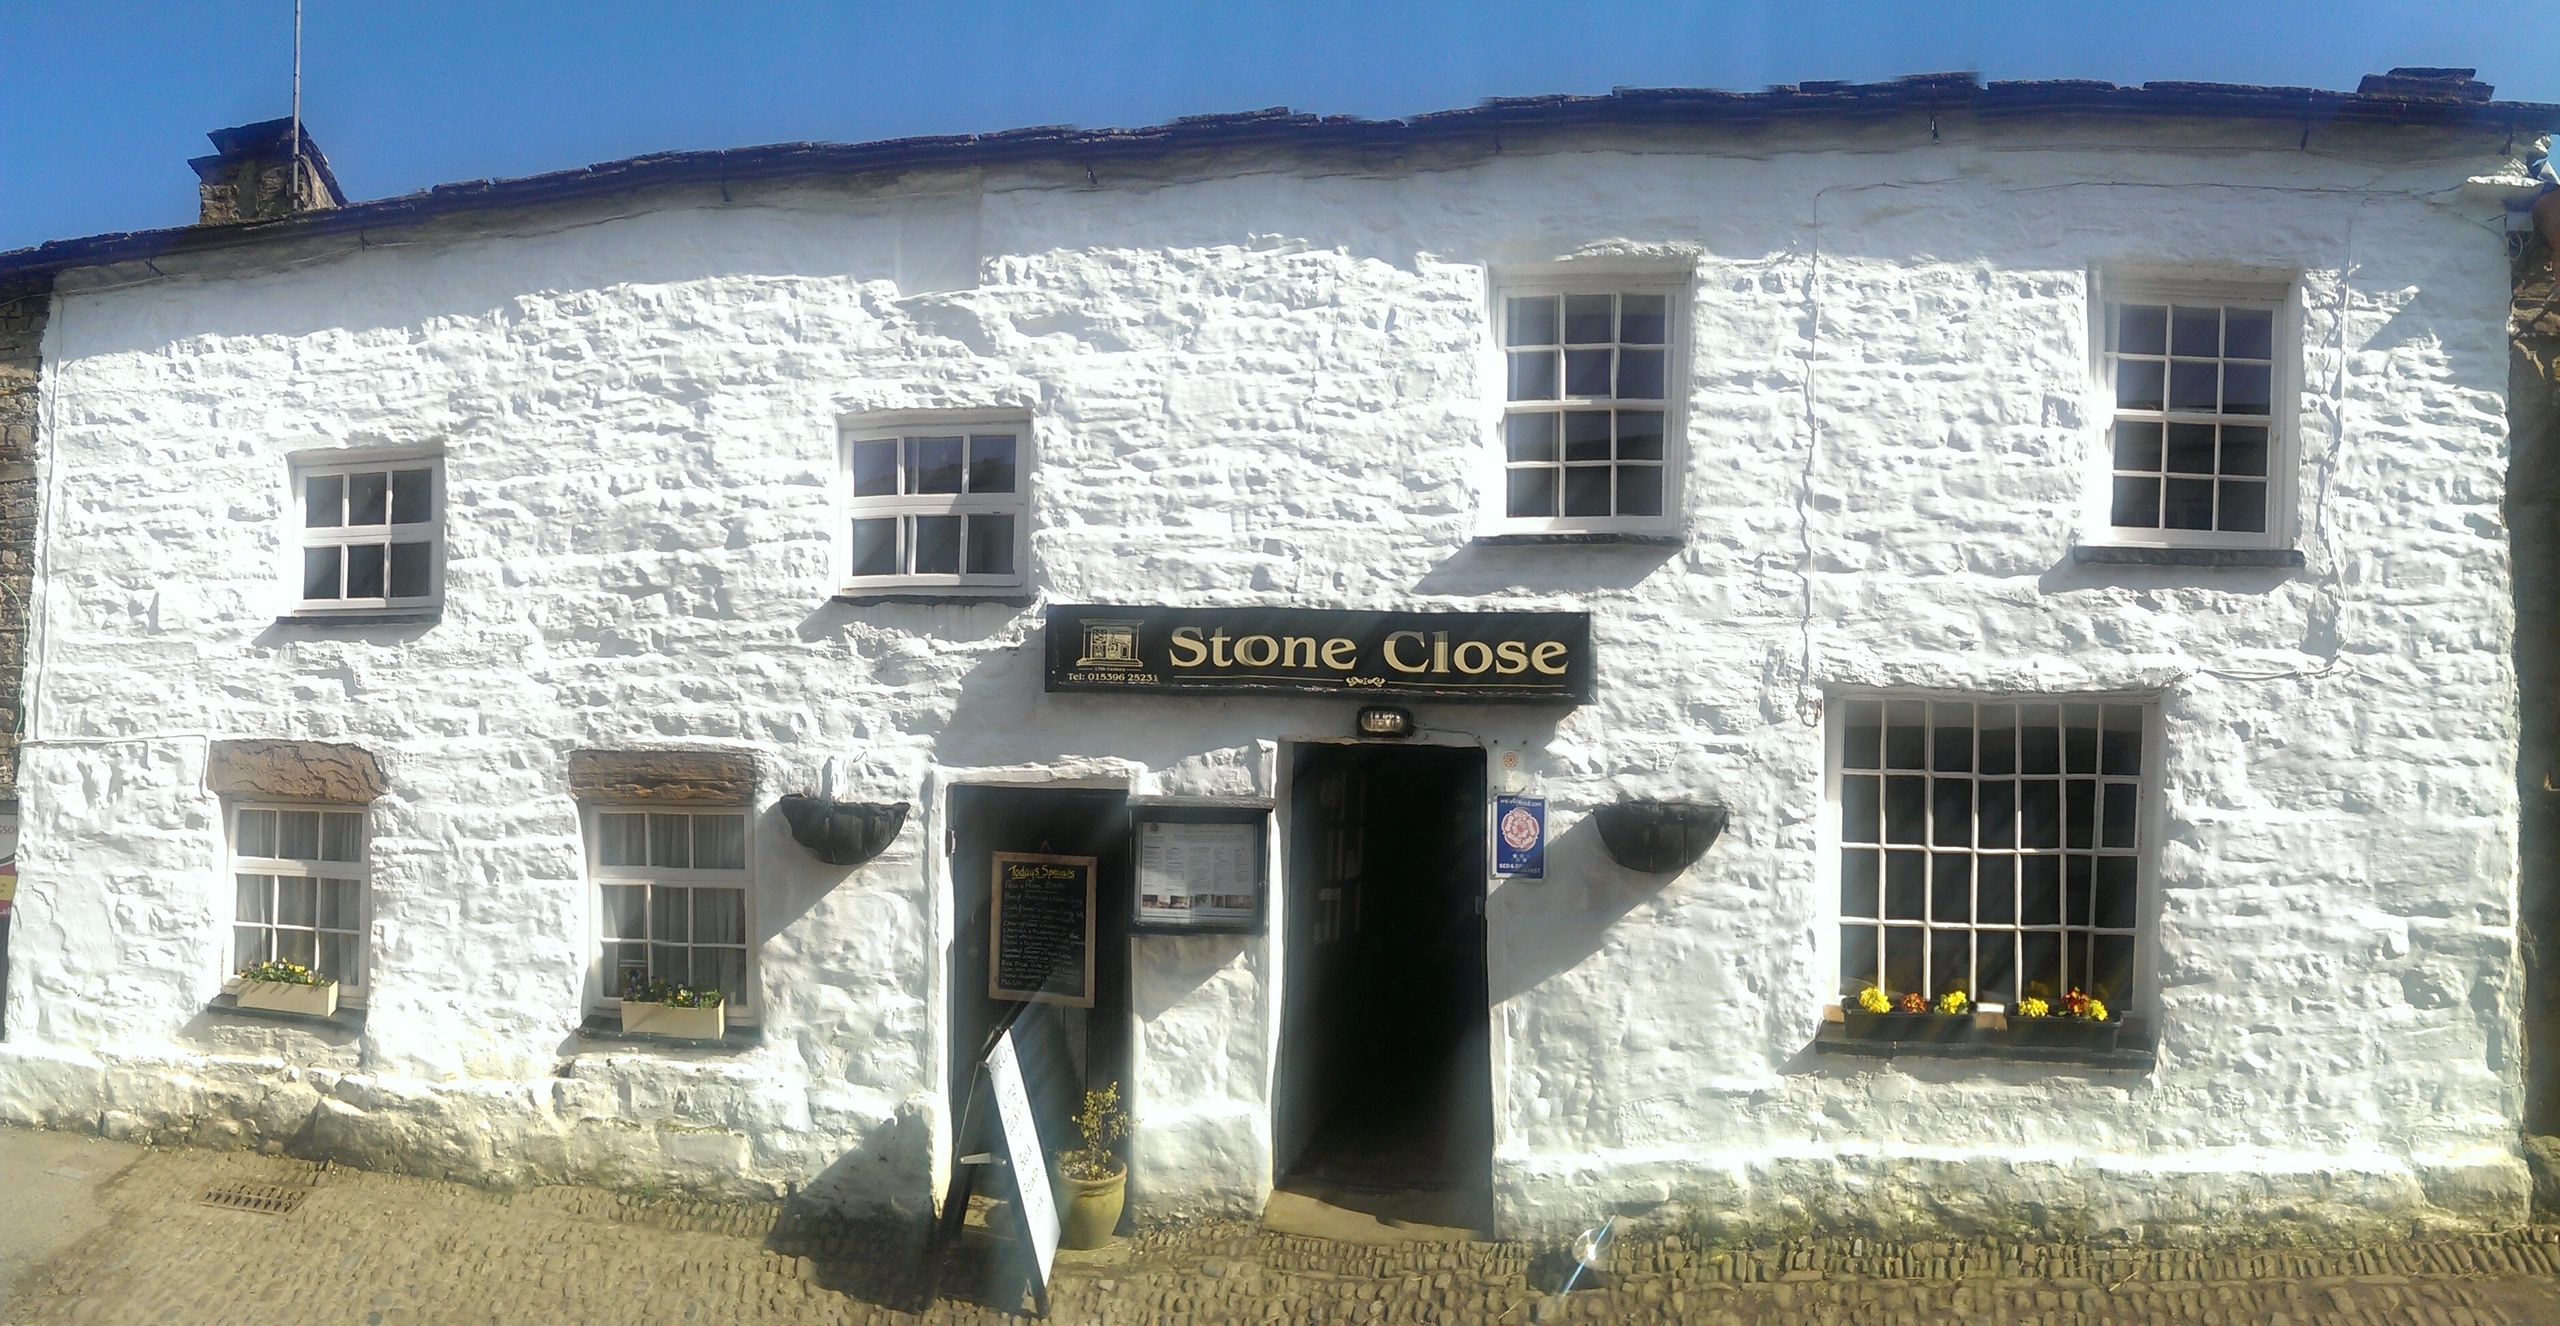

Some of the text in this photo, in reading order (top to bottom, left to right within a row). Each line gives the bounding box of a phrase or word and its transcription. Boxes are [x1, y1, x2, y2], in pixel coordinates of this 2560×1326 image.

[1169, 626, 1569, 675] Stone Close
[1067, 672, 1158, 682] Tel: 015396 25231
